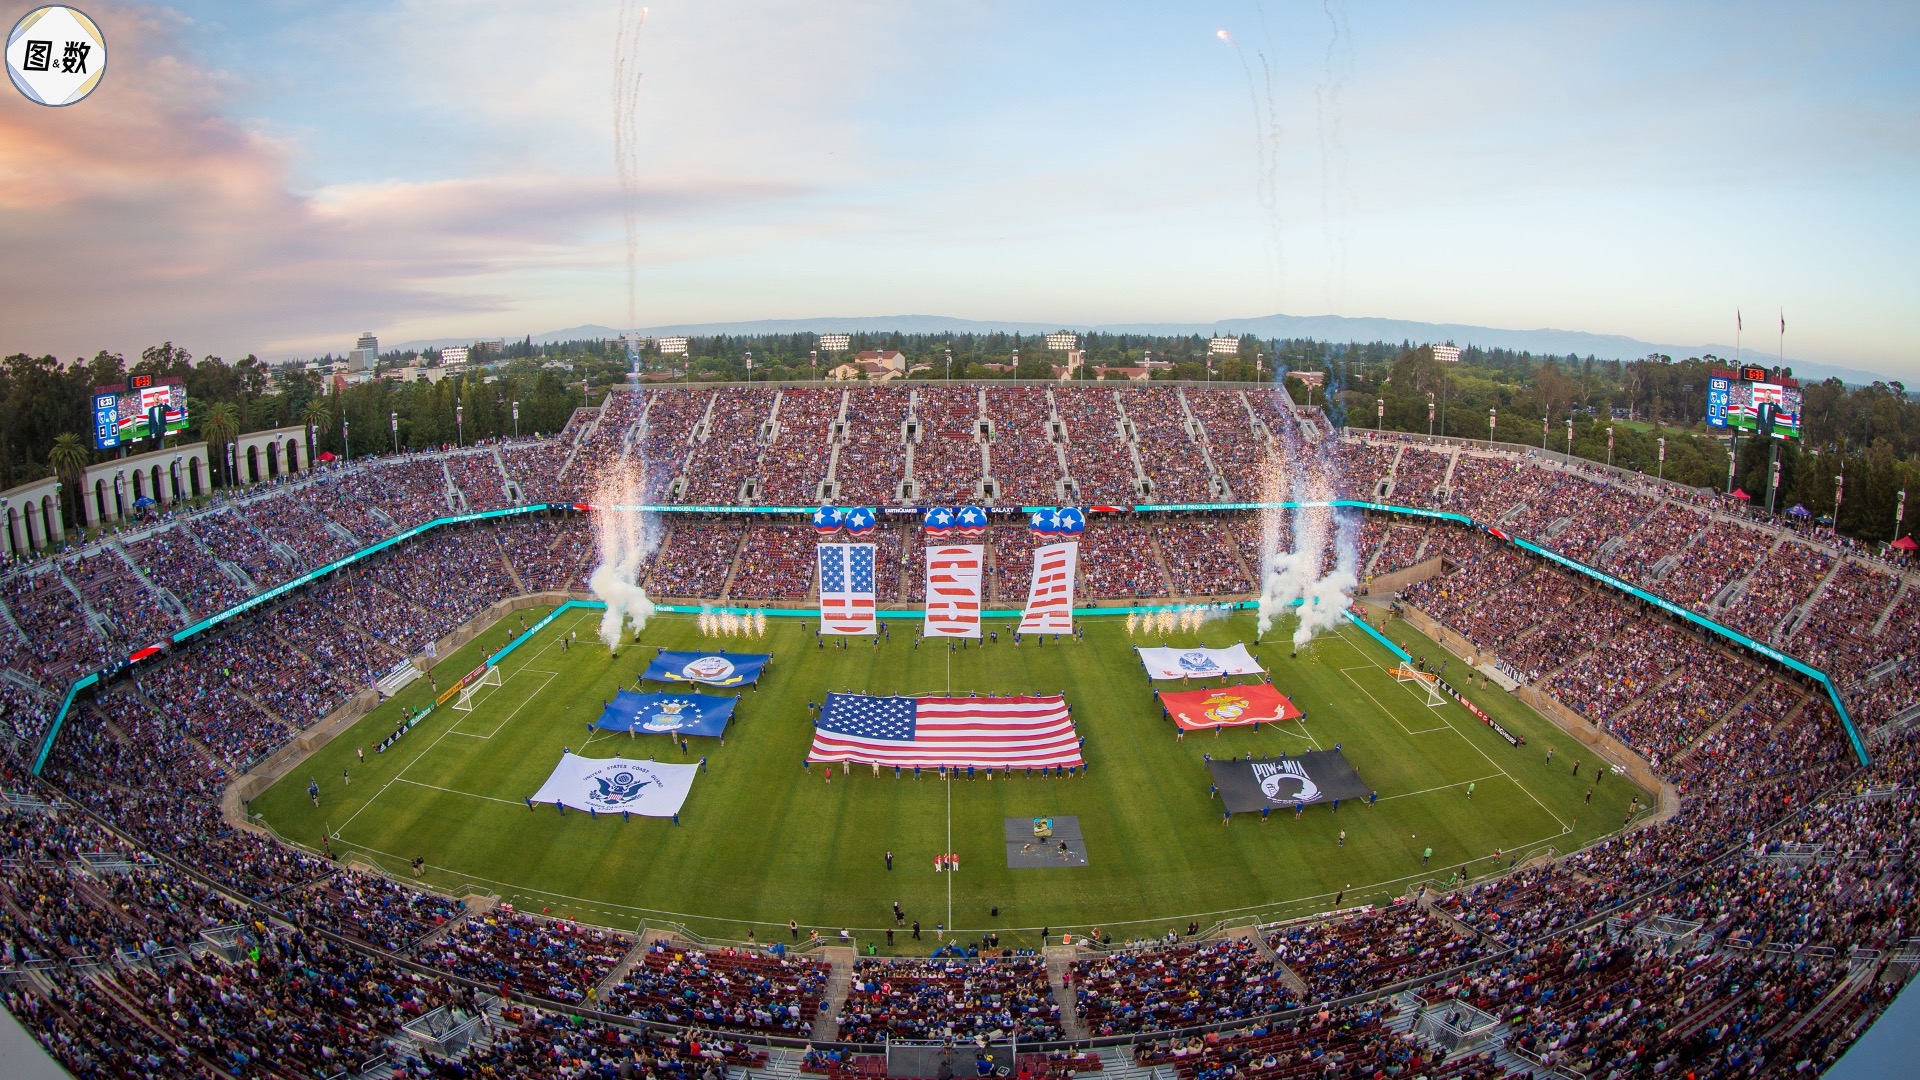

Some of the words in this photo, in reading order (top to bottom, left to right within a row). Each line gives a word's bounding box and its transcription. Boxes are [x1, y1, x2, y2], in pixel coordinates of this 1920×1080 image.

[1749, 369, 1764, 380] 6:33
[582, 769, 602, 782] UNITED
[631, 765, 650, 774] COAST
[651, 774, 664, 788] GUARD
